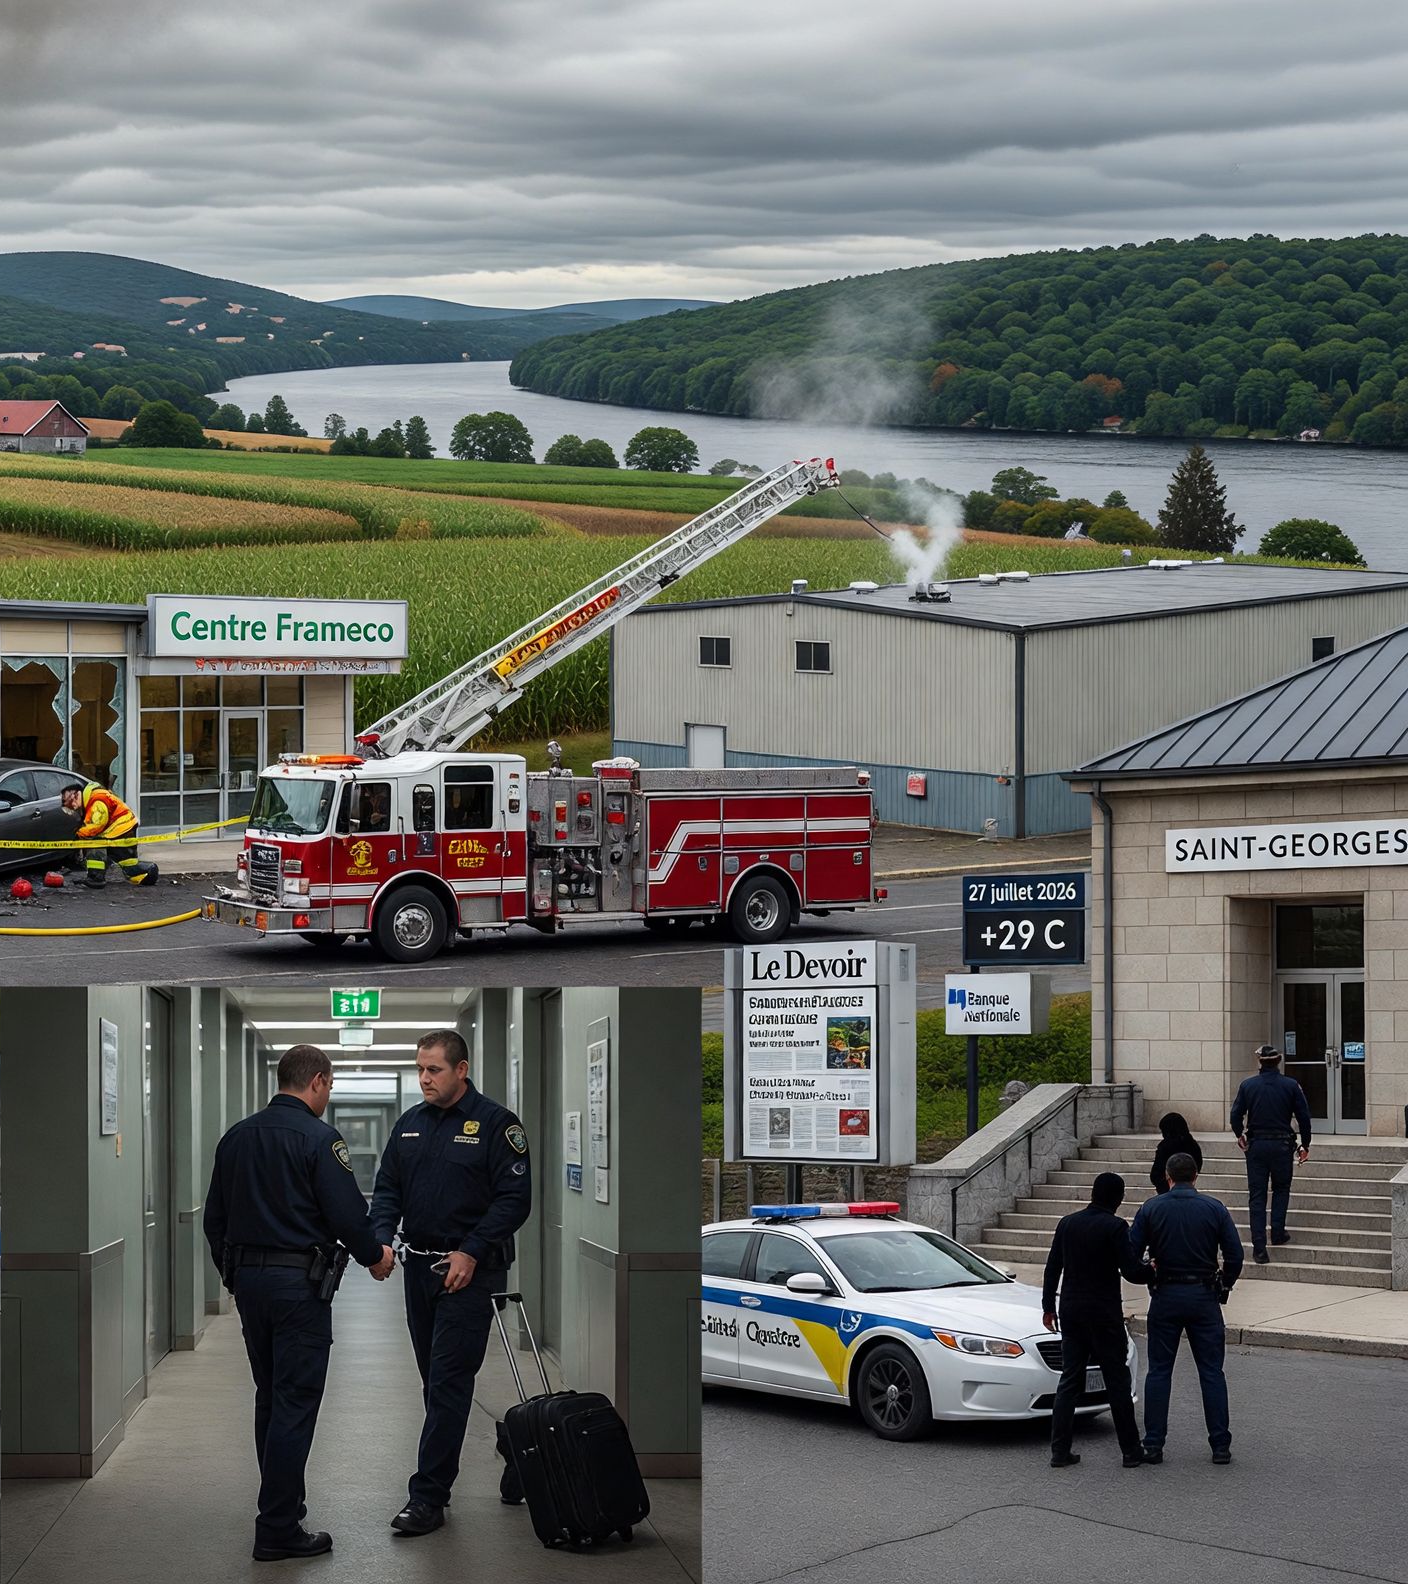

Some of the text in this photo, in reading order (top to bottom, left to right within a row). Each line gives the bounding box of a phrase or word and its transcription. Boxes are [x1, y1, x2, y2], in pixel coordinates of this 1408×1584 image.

[170, 611, 394, 643] Centre Frameco
[1175, 829, 1408, 862] SAINT-GEORGES
[968, 882, 1077, 905] 27 juillet 2026
[980, 919, 1066, 950] +29 C
[750, 948, 867, 981] Le Devoir
[968, 991, 1010, 1007] Banque
